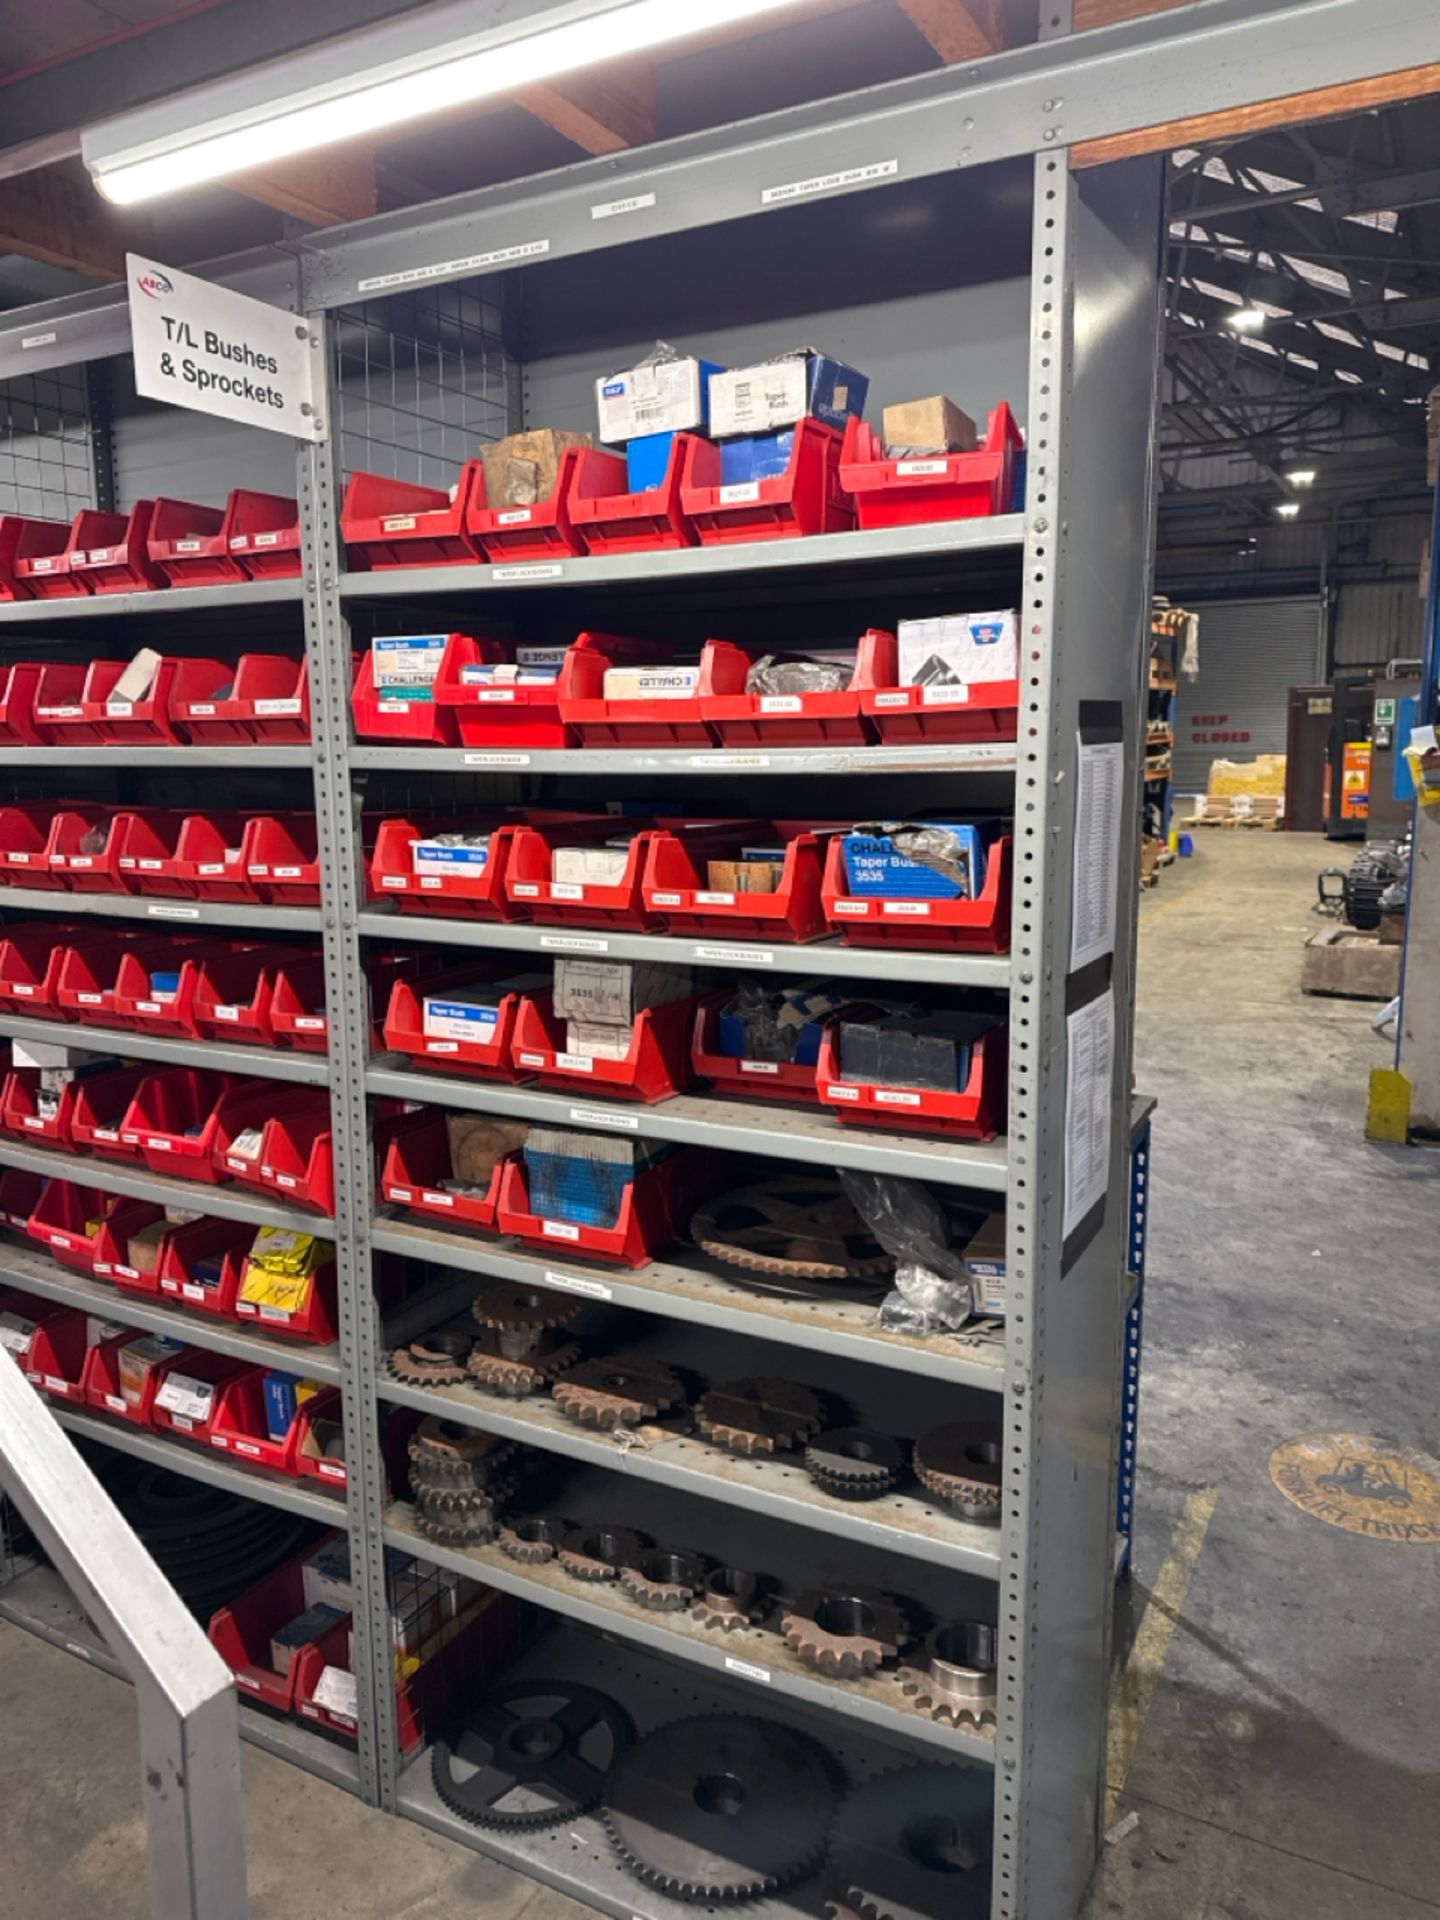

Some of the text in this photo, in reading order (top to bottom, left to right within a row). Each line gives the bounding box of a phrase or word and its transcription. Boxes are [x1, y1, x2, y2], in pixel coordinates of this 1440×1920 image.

[161, 316, 278, 374] T/L Bushes
[161, 352, 284, 409] & Sprockets
[1192, 715, 1228, 727] KEEP
[1192, 731, 1251, 744] CLOSED
[851, 842, 893, 855] CHALL
[853, 856, 922, 869] Taper Bus
[854, 871, 885, 882] 3535
